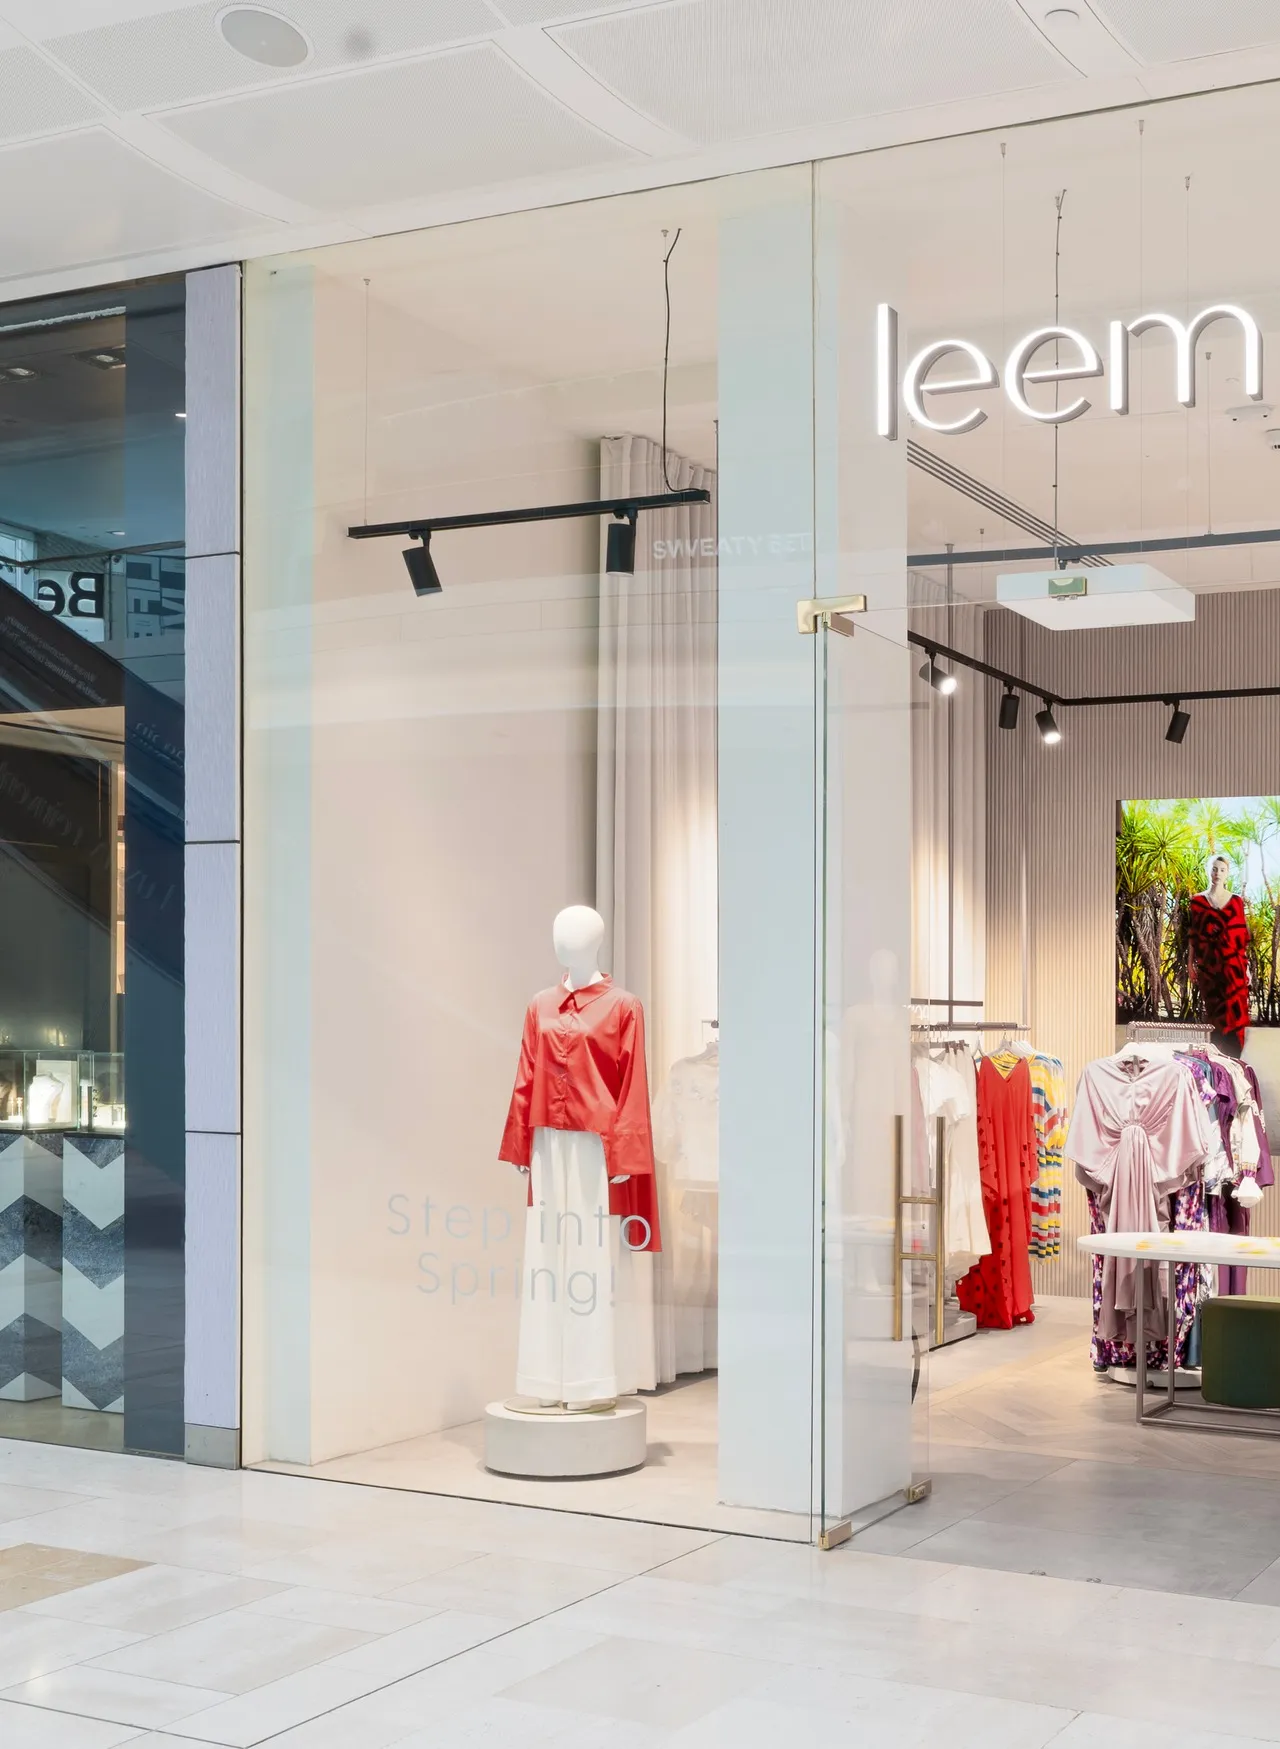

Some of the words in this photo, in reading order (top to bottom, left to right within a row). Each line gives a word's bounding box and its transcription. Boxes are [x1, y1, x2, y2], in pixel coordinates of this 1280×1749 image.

[877, 303, 1264, 441] leem
[387, 1193, 513, 1250] Step
[539, 1200, 652, 1252] into
[416, 1251, 617, 1317] Spring!
